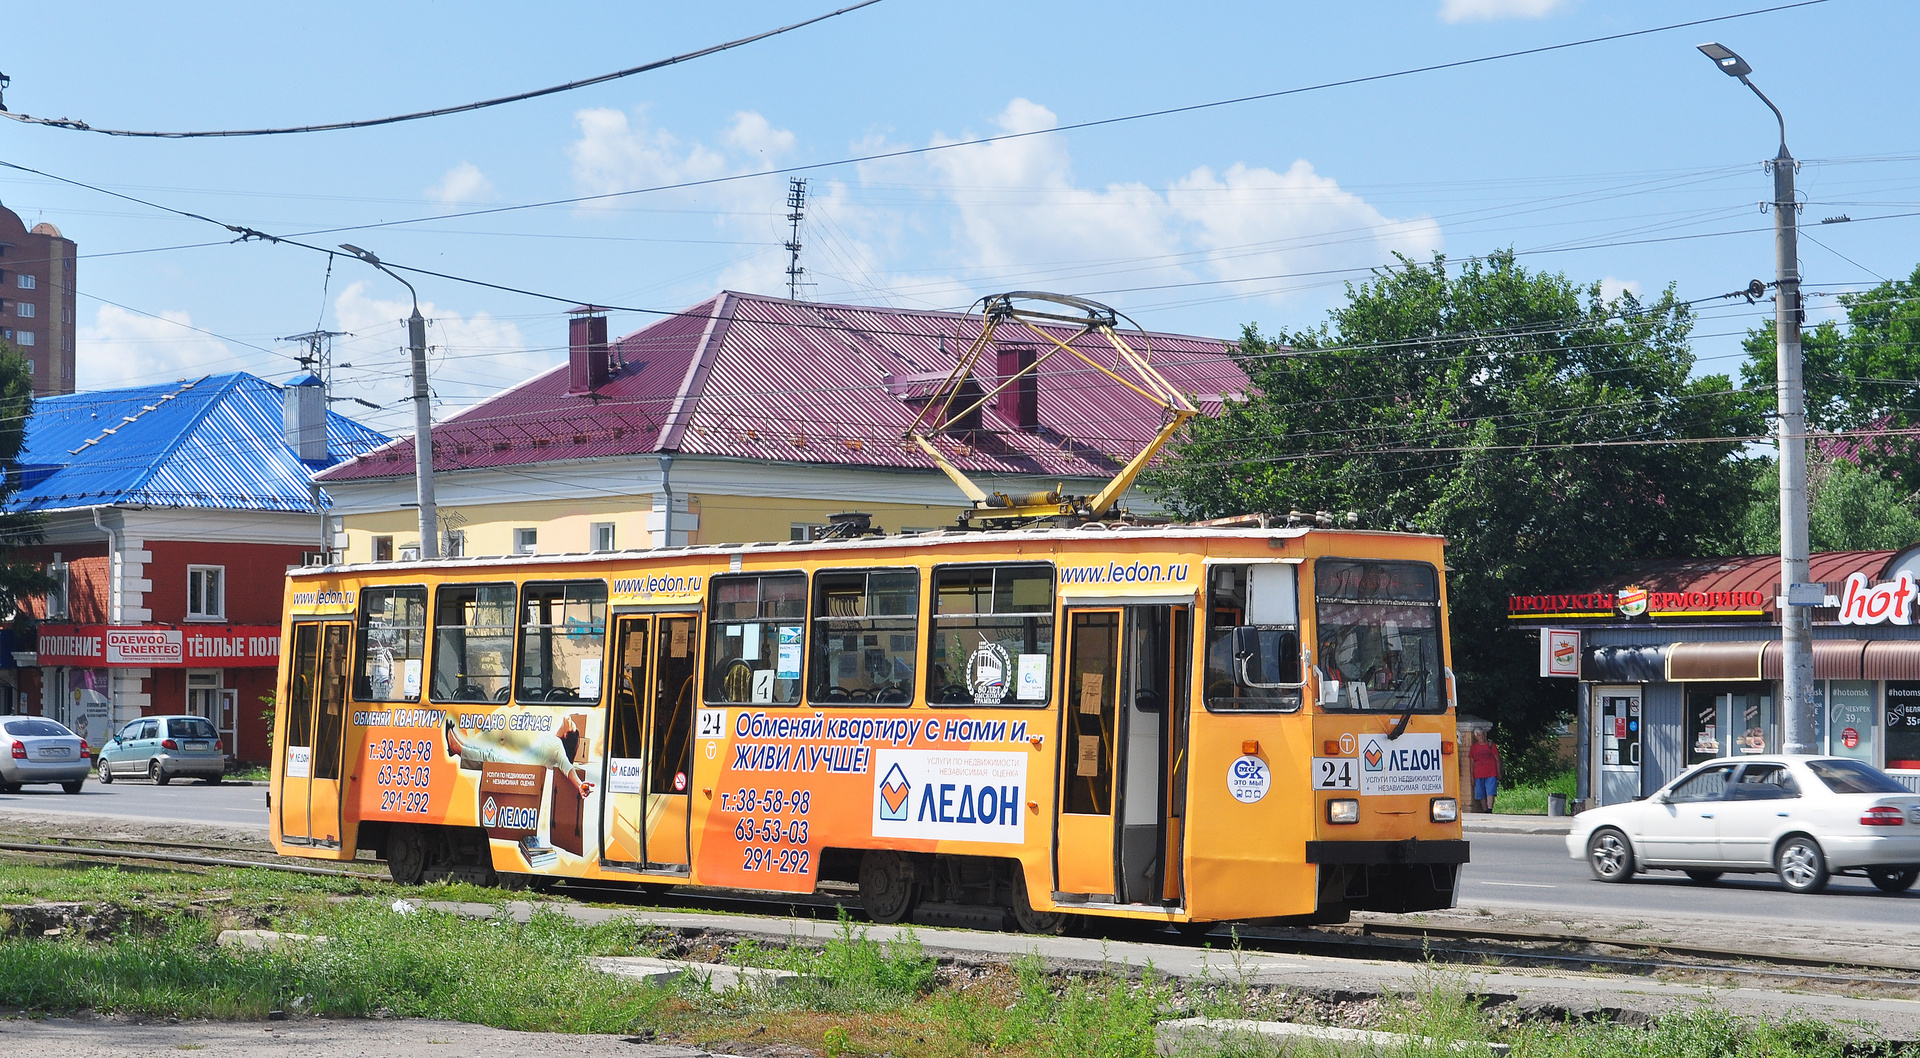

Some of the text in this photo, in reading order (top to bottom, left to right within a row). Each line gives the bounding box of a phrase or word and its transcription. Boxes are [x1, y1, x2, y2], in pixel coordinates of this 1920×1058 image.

[1060, 560, 1189, 584] www.ledon.ru
[614, 573, 703, 593] www.ledon.ru
[293, 588, 356, 605] www.ledon.ru
[1508, 593, 1614, 612] ПРОДУКТЫ
[1650, 590, 1764, 608] ЕРМОЛИНО
[1844, 577, 1910, 618] hot
[39, 636, 102, 657] ОТОПЛЕНИЕ
[111, 636, 165, 644] DAEWOO
[122, 646, 179, 654] ENERTEC
[186, 634, 244, 657] ТЁПЛЫЕ
[756, 675, 768, 699] 4
[353, 709, 447, 728] ОБМЕНЯЙ КВАРТИРУ
[459, 712, 553, 732] ВЫГОДНО СЕЙЧАС!
[702, 713, 720, 735] 24
[1845, 713, 1856, 723] 39
[735, 711, 824, 739] Обменяй
[825, 717, 922, 747] квартиру
[925, 717, 941, 742] с
[943, 717, 1008, 743] нами
[731, 743, 871, 774] ЖИВИ ЛУЧШЕ!
[927, 757, 951, 765] УСЛУГИ
[963, 758, 1020, 767] НЕДВИЖИМОСТИ
[1389, 749, 1440, 772] ЛЕДОН
[377, 764, 430, 788] 63-53-03
[618, 766, 640, 776] ЛЕДОН
[939, 767, 988, 776] НЕЗАВИСИМАЯ
[992, 769, 1019, 778] ОЦЕНКА
[1322, 761, 1352, 787] 24
[1365, 776, 1388, 784] УСЛУГИ
[1398, 775, 1441, 783] НЕДВИЖИМОСТИ
[1378, 784, 1419, 792] НЕЗАВИСИМАЯ
[1421, 783, 1442, 791] ОЦЕНКА
[381, 790, 430, 814] 291-292
[917, 783, 1019, 826] ЛЕДОН
[498, 806, 538, 830] ЛЕДОН
[735, 817, 809, 845] 63-53-03
[743, 846, 810, 875] 291-292
